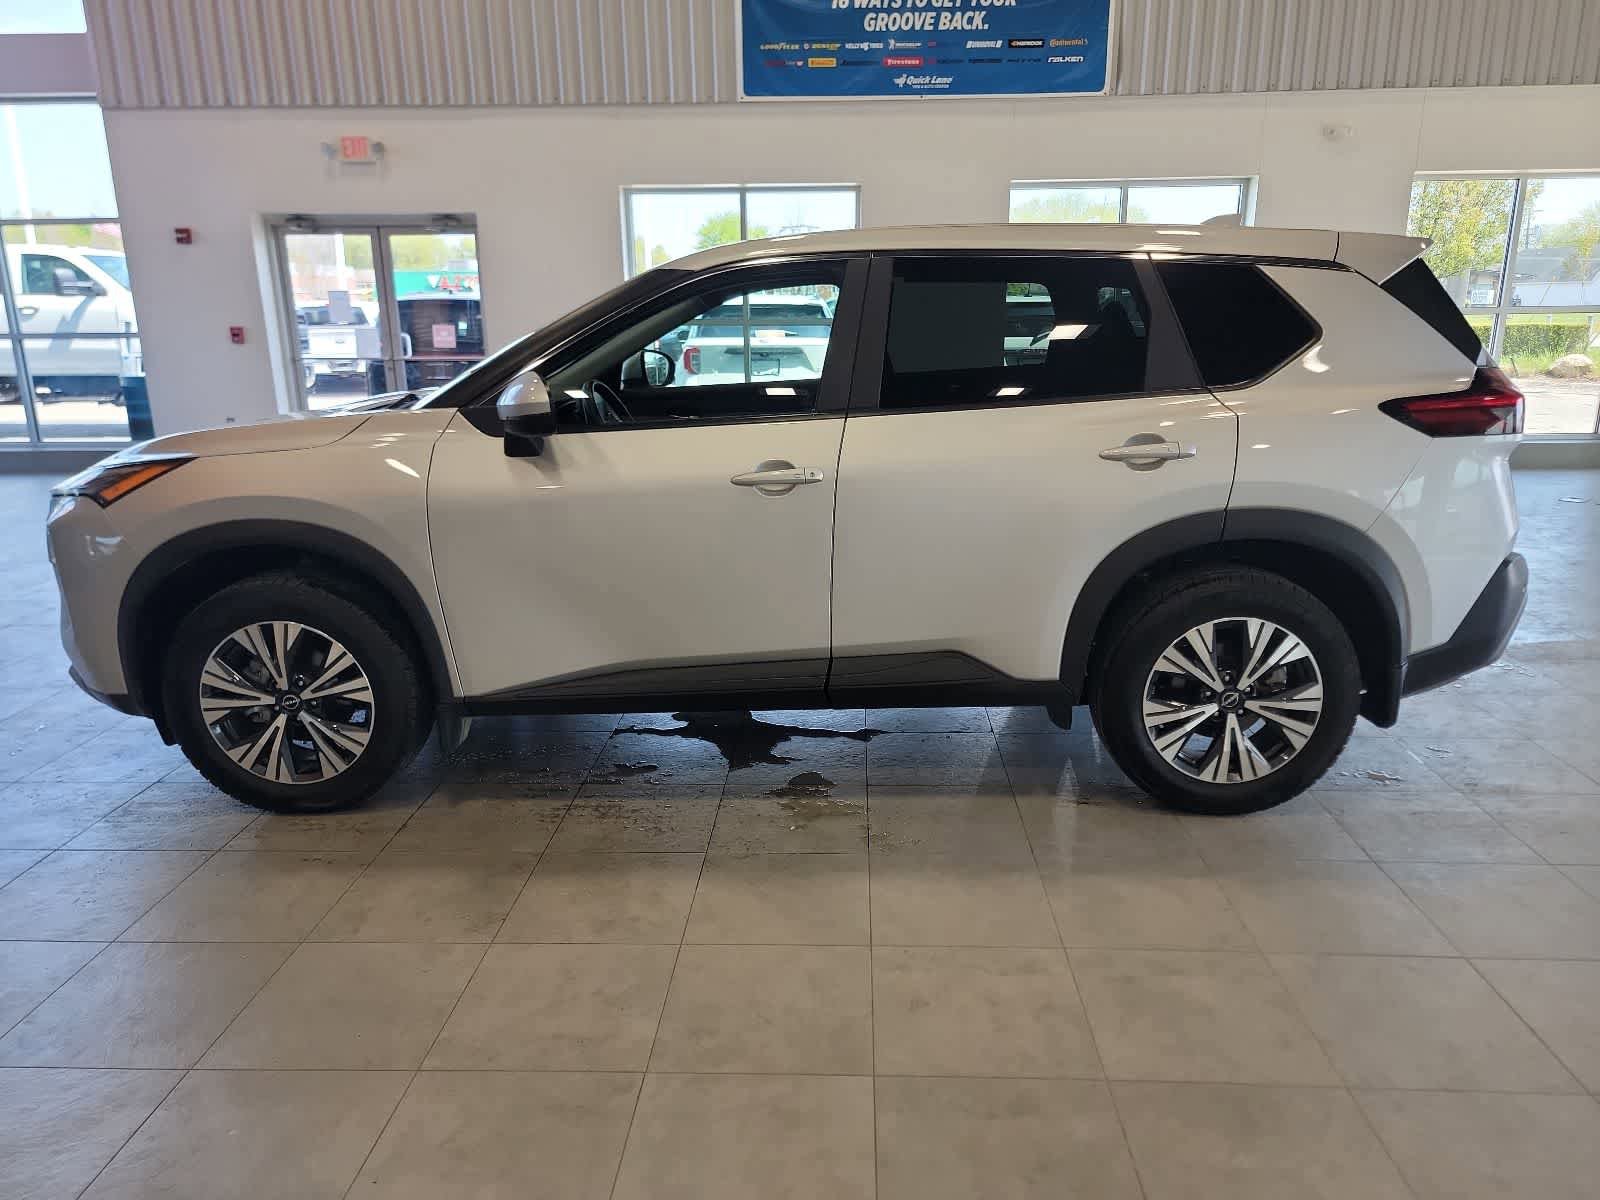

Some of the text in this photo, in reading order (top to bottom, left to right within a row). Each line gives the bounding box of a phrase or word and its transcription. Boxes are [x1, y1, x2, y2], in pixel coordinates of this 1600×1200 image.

[863, 11, 990, 32] GROOVE BACK.
[906, 75, 953, 85] Quick Lane
